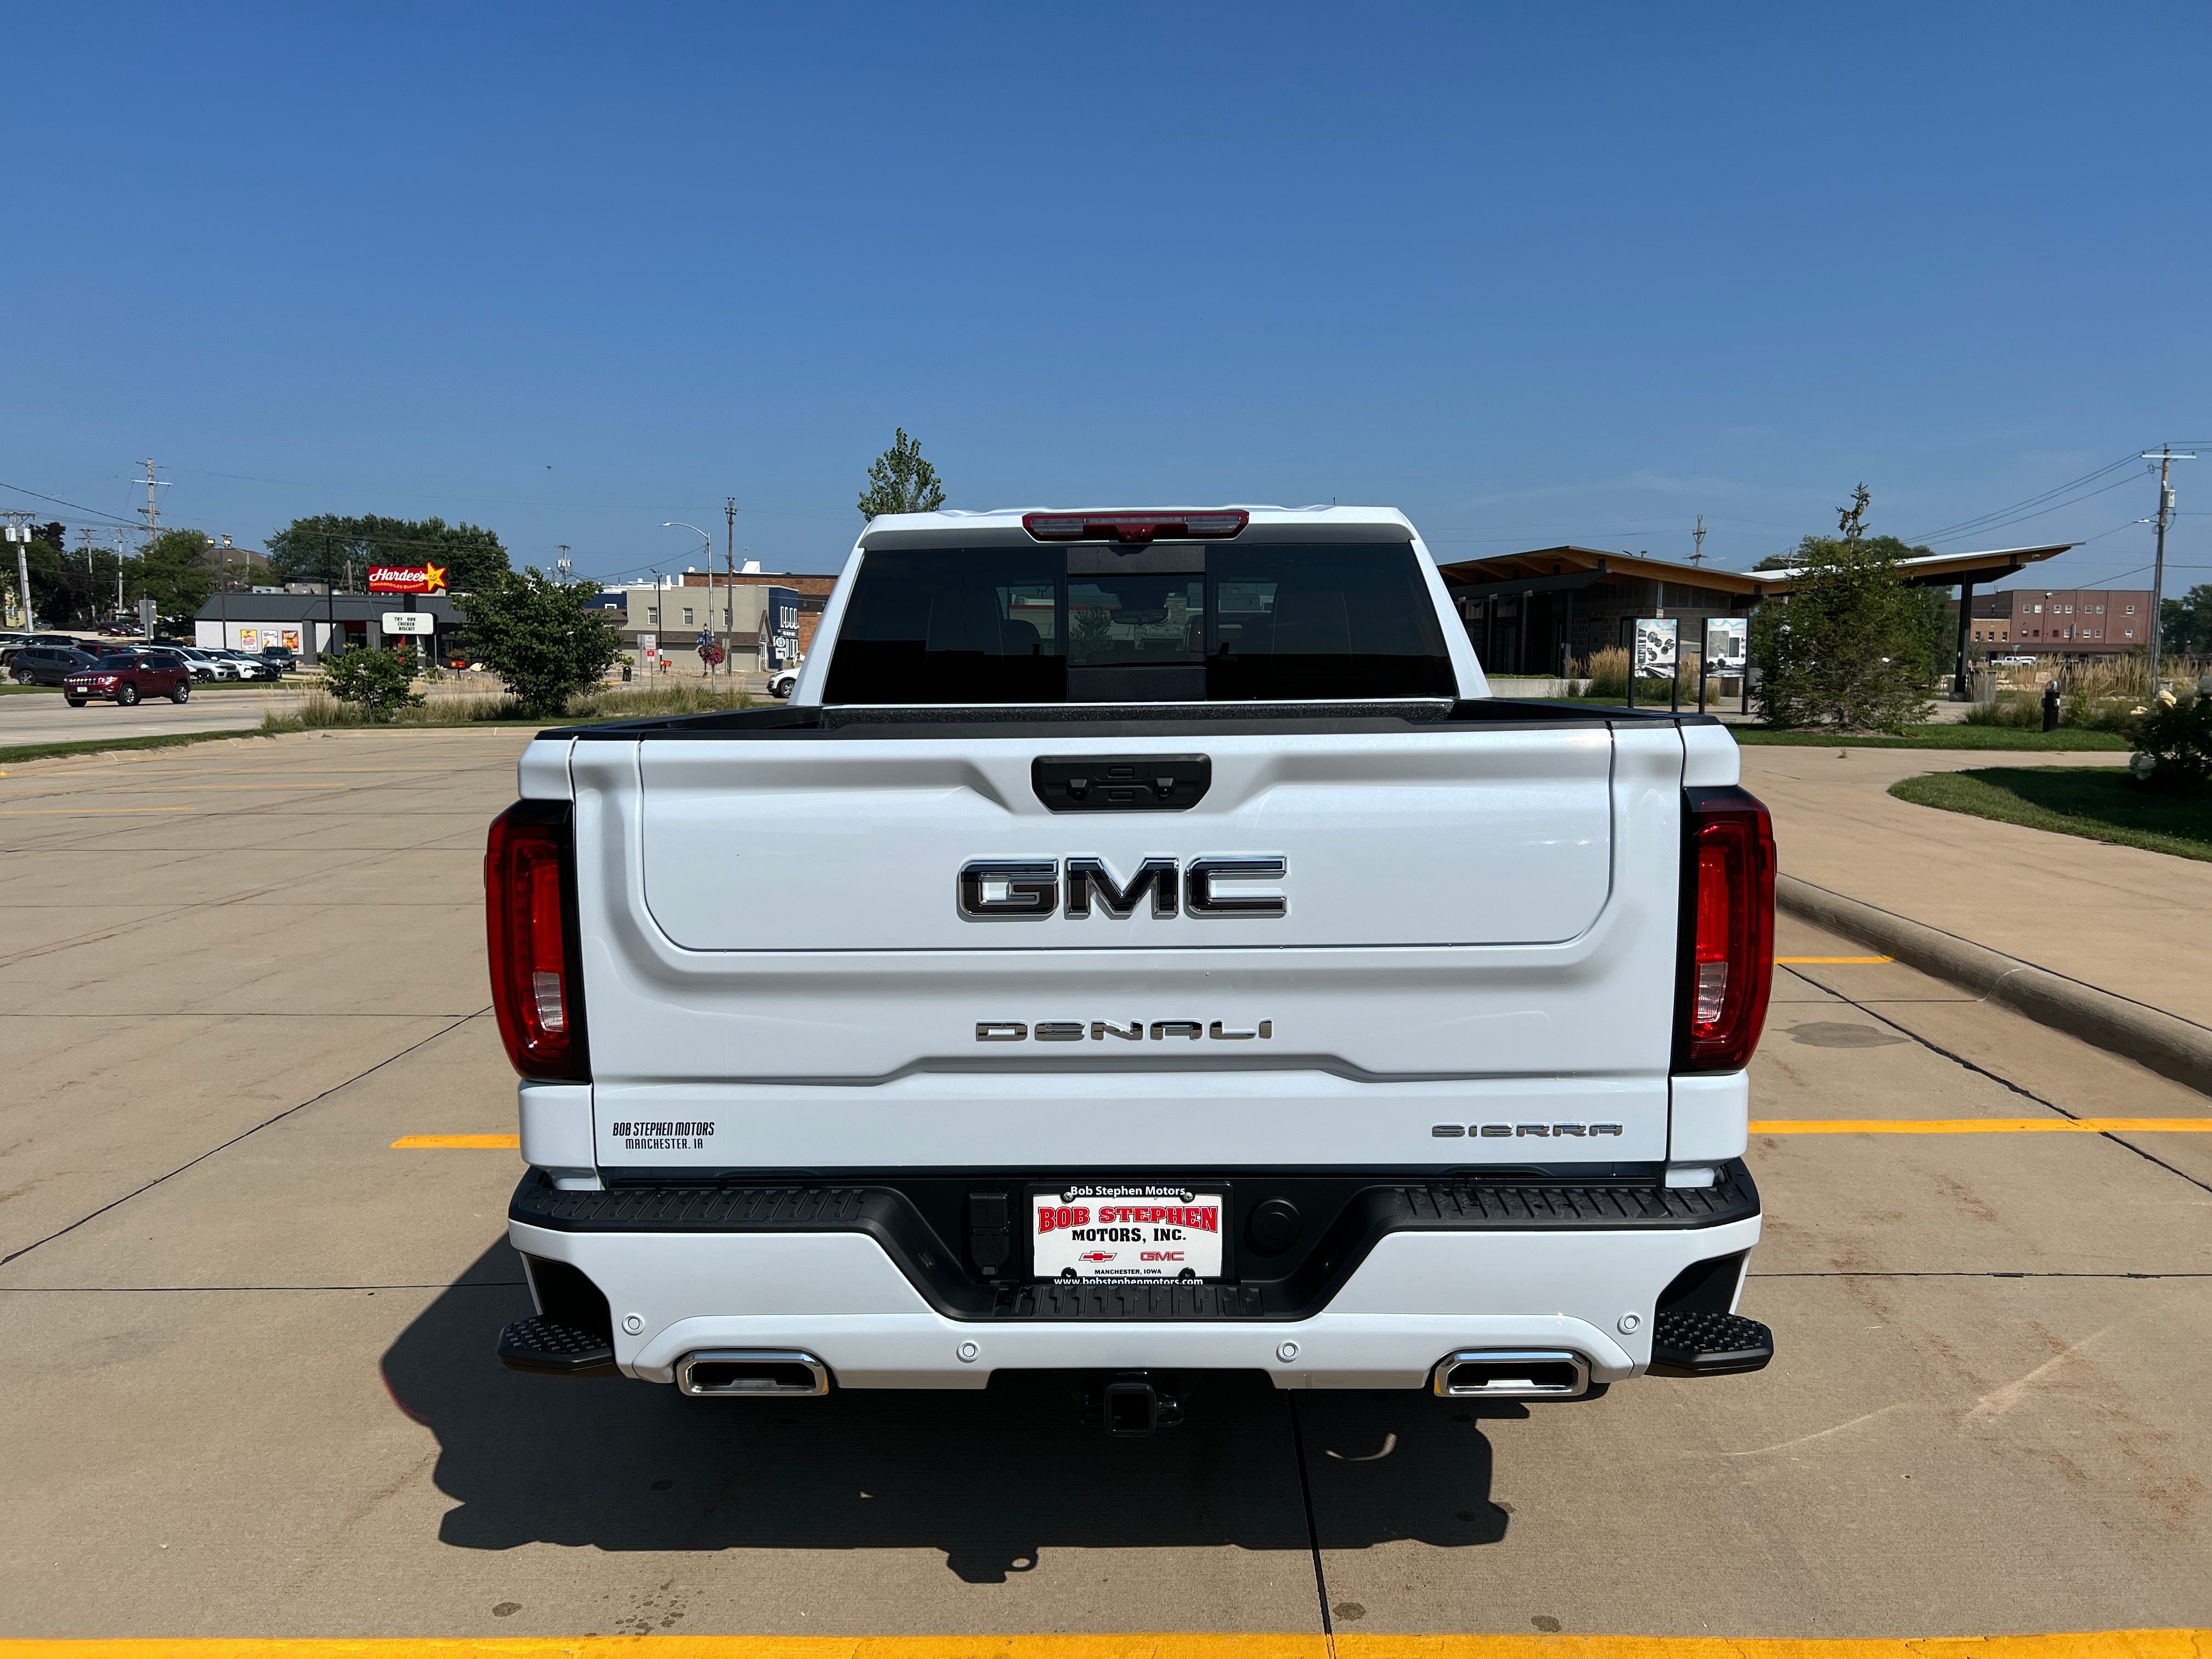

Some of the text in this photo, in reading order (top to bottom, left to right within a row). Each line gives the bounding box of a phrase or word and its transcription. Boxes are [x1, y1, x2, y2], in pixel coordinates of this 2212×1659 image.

[369, 568, 426, 582] Hardee's
[959, 856, 1287, 916] GMC
[976, 1019, 1272, 1041] DENALI
[613, 1122, 715, 1136] BOB STEPHEN MOTORS
[1432, 1123, 1623, 1137] SIERRA
[694, 1138, 703, 1149] IA
[1070, 1186, 1186, 1197] Bob Stephen Motors
[1038, 1206, 1218, 1234] BOB STEPHEN
[1071, 1227, 1187, 1244] MOTORS, INC.
[1140, 1251, 1184, 1261] GMC
